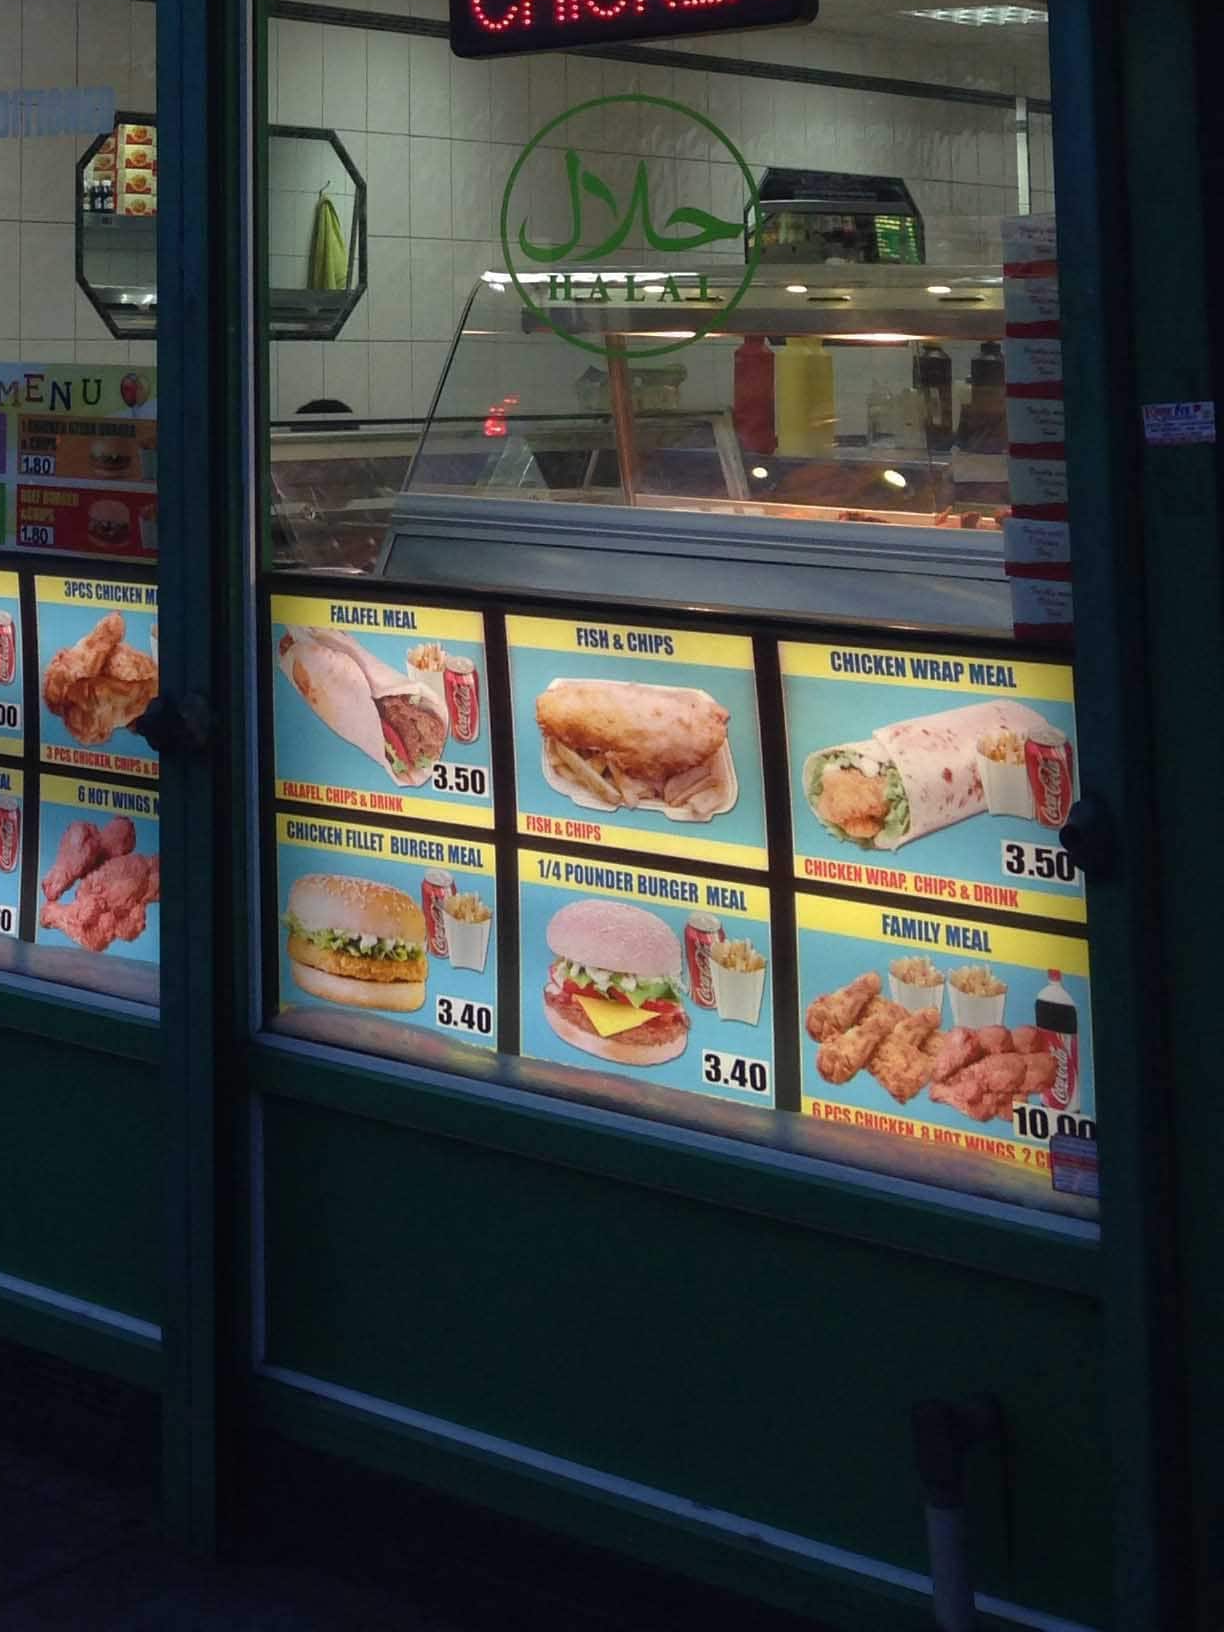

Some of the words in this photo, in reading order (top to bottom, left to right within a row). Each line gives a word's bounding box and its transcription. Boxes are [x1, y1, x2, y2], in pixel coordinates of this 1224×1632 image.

[519, 147, 745, 263] حلال
[22, 456, 52, 475] 1.80
[20, 526, 49, 546] 1.80
[64, 580, 94, 600] 3PCS
[95, 583, 143, 605] CHICKEN
[330, 604, 380, 627] FALAFEL
[382, 608, 418, 631] MEAL
[576, 626, 609, 649] FISH
[613, 633, 624, 651] &
[627, 631, 674, 656] CHIPS
[829, 650, 907, 679] CHICKEN
[909, 658, 965, 683] WRAP
[968, 662, 1018, 689] MEAL
[432, 763, 487, 796] 3.50
[77, 785, 86, 802] 6
[87, 787, 110, 806] HOT
[112, 791, 151, 815] WINGS
[325, 786, 359, 807] CHIPS
[359, 793, 369, 807] &
[369, 793, 404, 814] DRINK
[286, 819, 343, 848] CHICKEN
[345, 827, 384, 853] FILLET
[389, 833, 445, 863] BURGER
[447, 843, 484, 869] MEAL
[525, 814, 553, 836] FISH
[554, 821, 564, 836] &
[565, 820, 602, 842] CHIPS
[1005, 843, 1076, 882] 3.50
[537, 858, 562, 881] 1/4
[564, 863, 634, 893] POUNDER
[637, 873, 699, 905] BURGER
[705, 884, 749, 912] MEAL
[804, 858, 863, 884] CHICKEN
[913, 874, 958, 899] CHIPS
[959, 884, 971, 901] &
[973, 883, 1019, 909] DRINK
[881, 913, 941, 946] FAMILY
[944, 923, 993, 954] MEAL
[437, 998, 493, 1035] 3.40
[703, 1052, 768, 1093] 3.40
[811, 1101, 822, 1119] 6
[825, 1103, 852, 1125] PCS
[854, 1110, 915, 1139] CHICKEN
[934, 1127, 962, 1146] HOT
[964, 1133, 1016, 1160] WINGS
[1013, 1106, 1097, 1141] 1000
